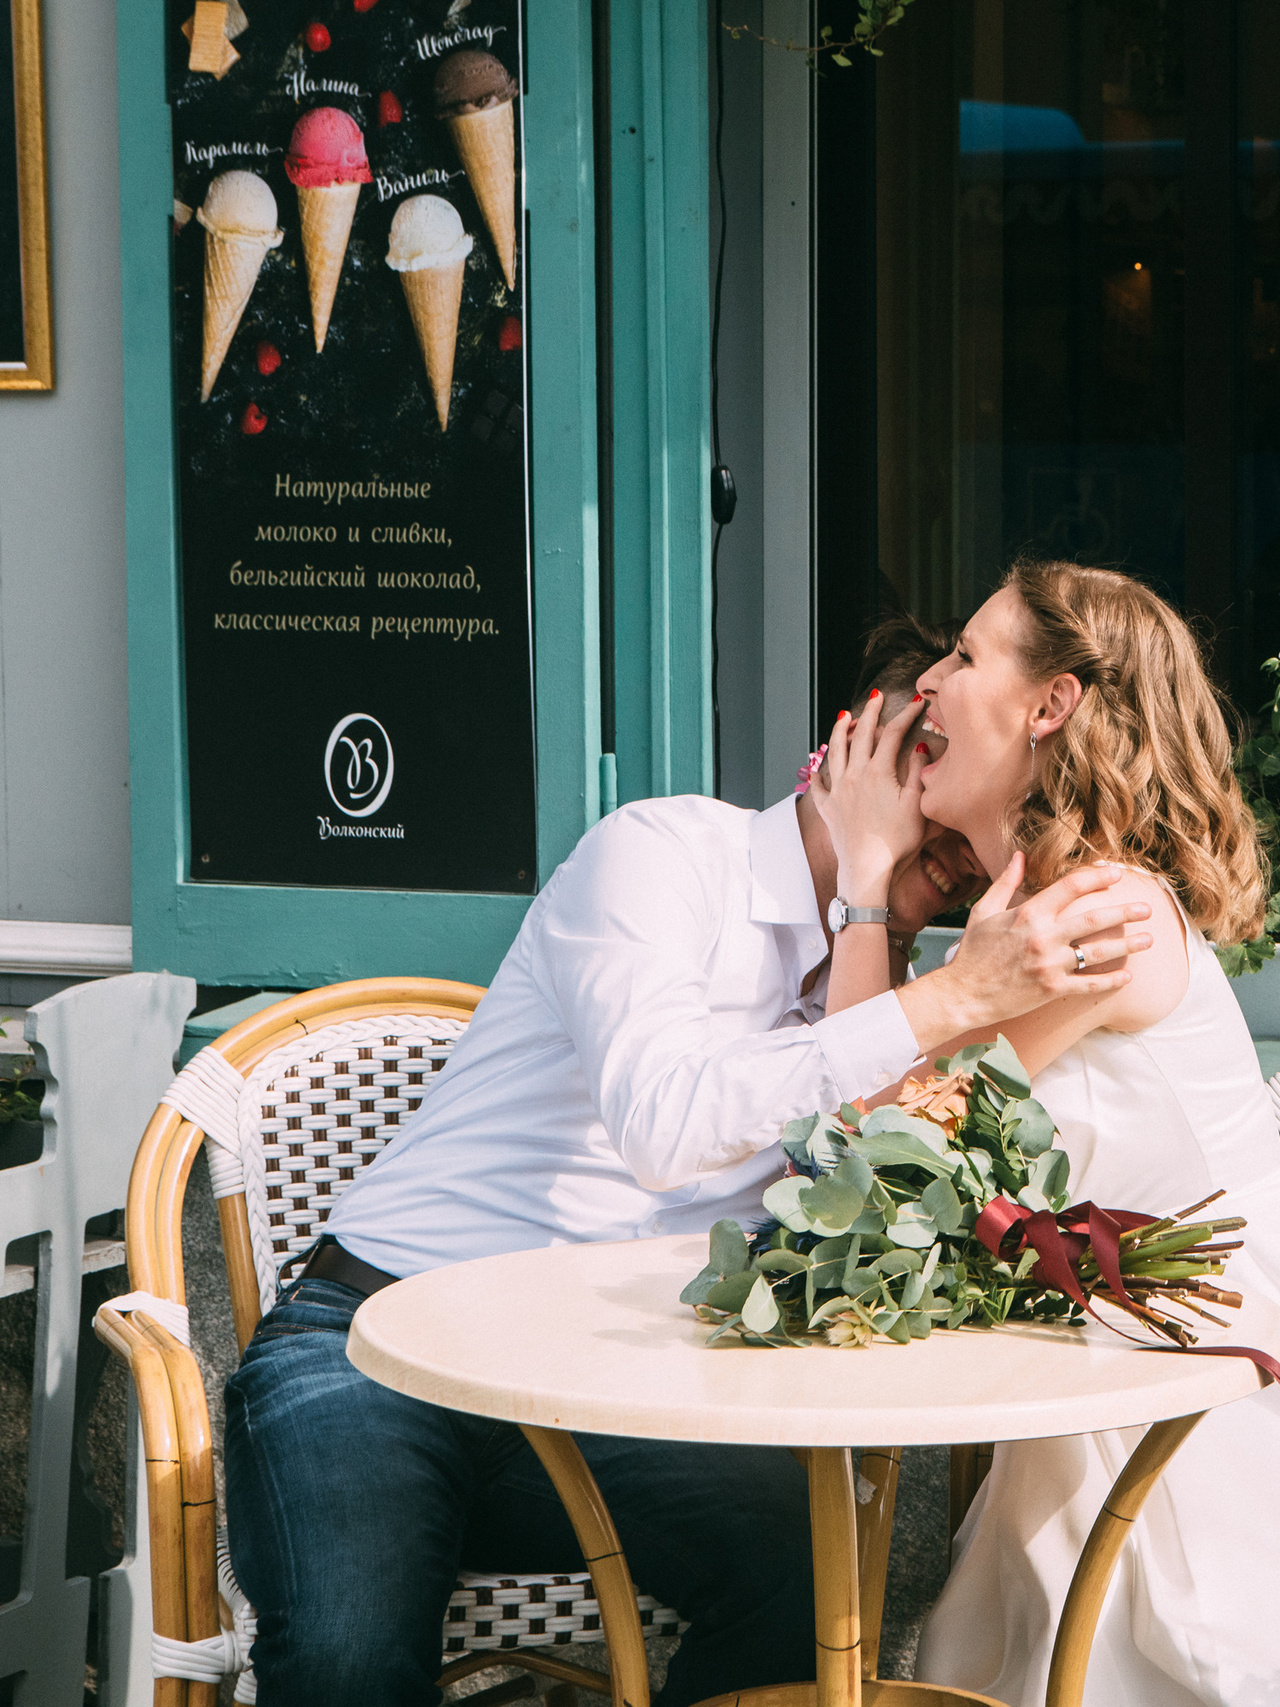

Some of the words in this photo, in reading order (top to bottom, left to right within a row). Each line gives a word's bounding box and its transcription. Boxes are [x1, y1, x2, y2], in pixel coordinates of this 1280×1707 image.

[416, 25, 507, 60] Шоколад
[285, 70, 372, 101] Малина
[185, 141, 283, 169] Карамель
[376, 169, 466, 203] Ваниль
[274, 473, 432, 505] Натуральные
[254, 525, 337, 543] молоко
[348, 526, 360, 543] и
[371, 522, 453, 548] сливки,
[229, 560, 366, 588] бельгийский
[377, 565, 482, 593] шоколад,
[214, 613, 361, 633] классическая
[371, 616, 500, 642] рецептура.
[316, 815, 405, 840] Волконский
